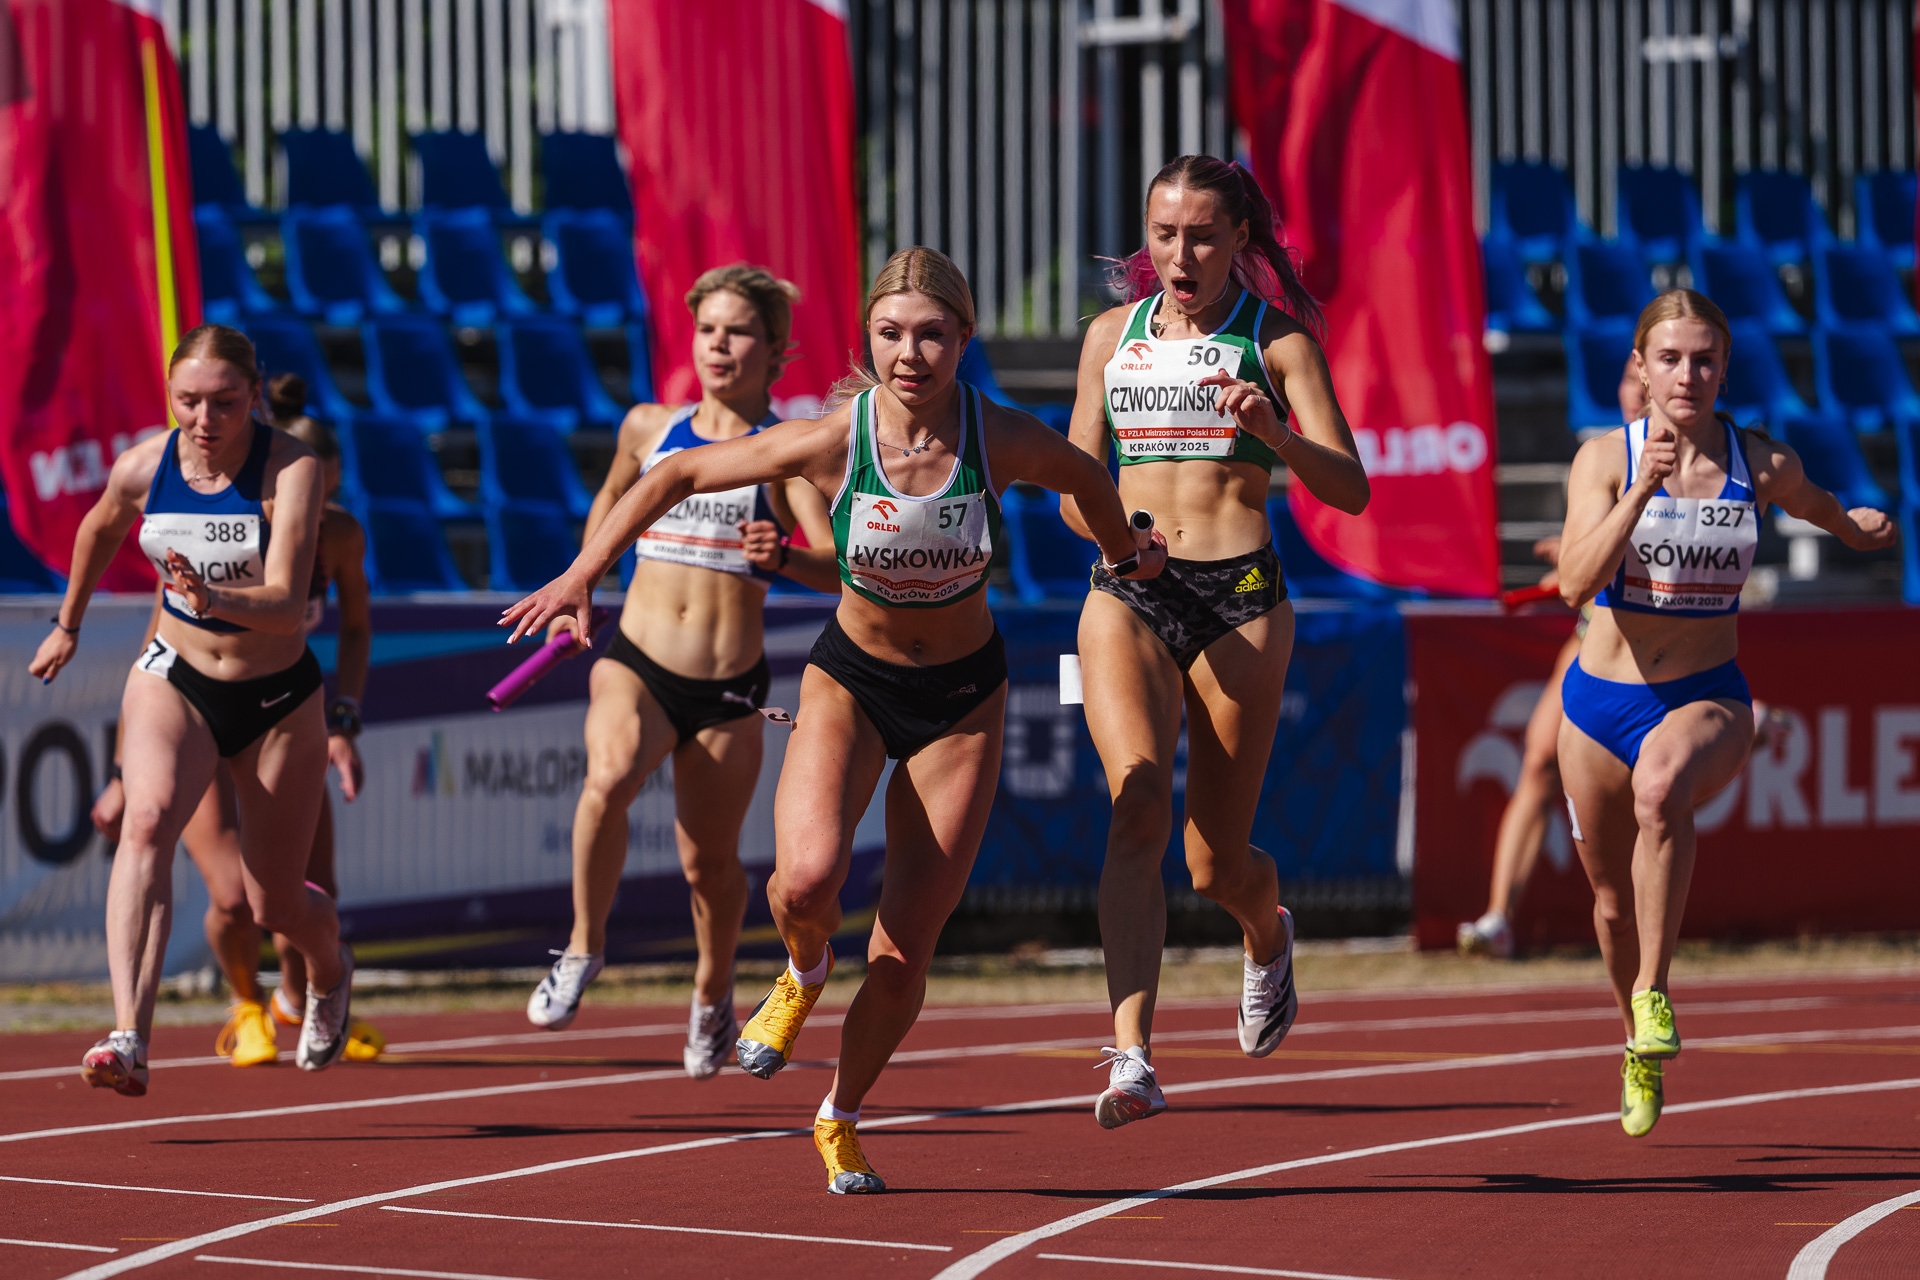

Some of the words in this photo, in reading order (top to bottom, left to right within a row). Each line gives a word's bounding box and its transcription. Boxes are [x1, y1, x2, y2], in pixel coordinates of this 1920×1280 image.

[1187, 345, 1221, 366] 50
[1121, 363, 1152, 371] ORLEN
[1110, 381, 1218, 412] CZWODZIŃSK
[1145, 429, 1184, 437] Mistrzostwa
[1129, 440, 1177, 452] KRAKÓW
[1180, 442, 1210, 451] 2025
[938, 502, 968, 529] 57
[1646, 508, 1686, 520] Kraków
[1701, 505, 1745, 528] 327
[205, 522, 246, 542] 388
[867, 521, 900, 533] ORLEN
[852, 544, 985, 570] ŁYSKOWKA
[1638, 538, 1741, 570] SÓWKA
[877, 585, 931, 600] KRAKÓW
[934, 582, 960, 599] 2025
[893, 579, 938, 589] Mistrzostwa
[1235, 579, 1269, 593] adidas
[1646, 593, 1695, 607] KRAKÓW
[1697, 596, 1724, 607] 2025
